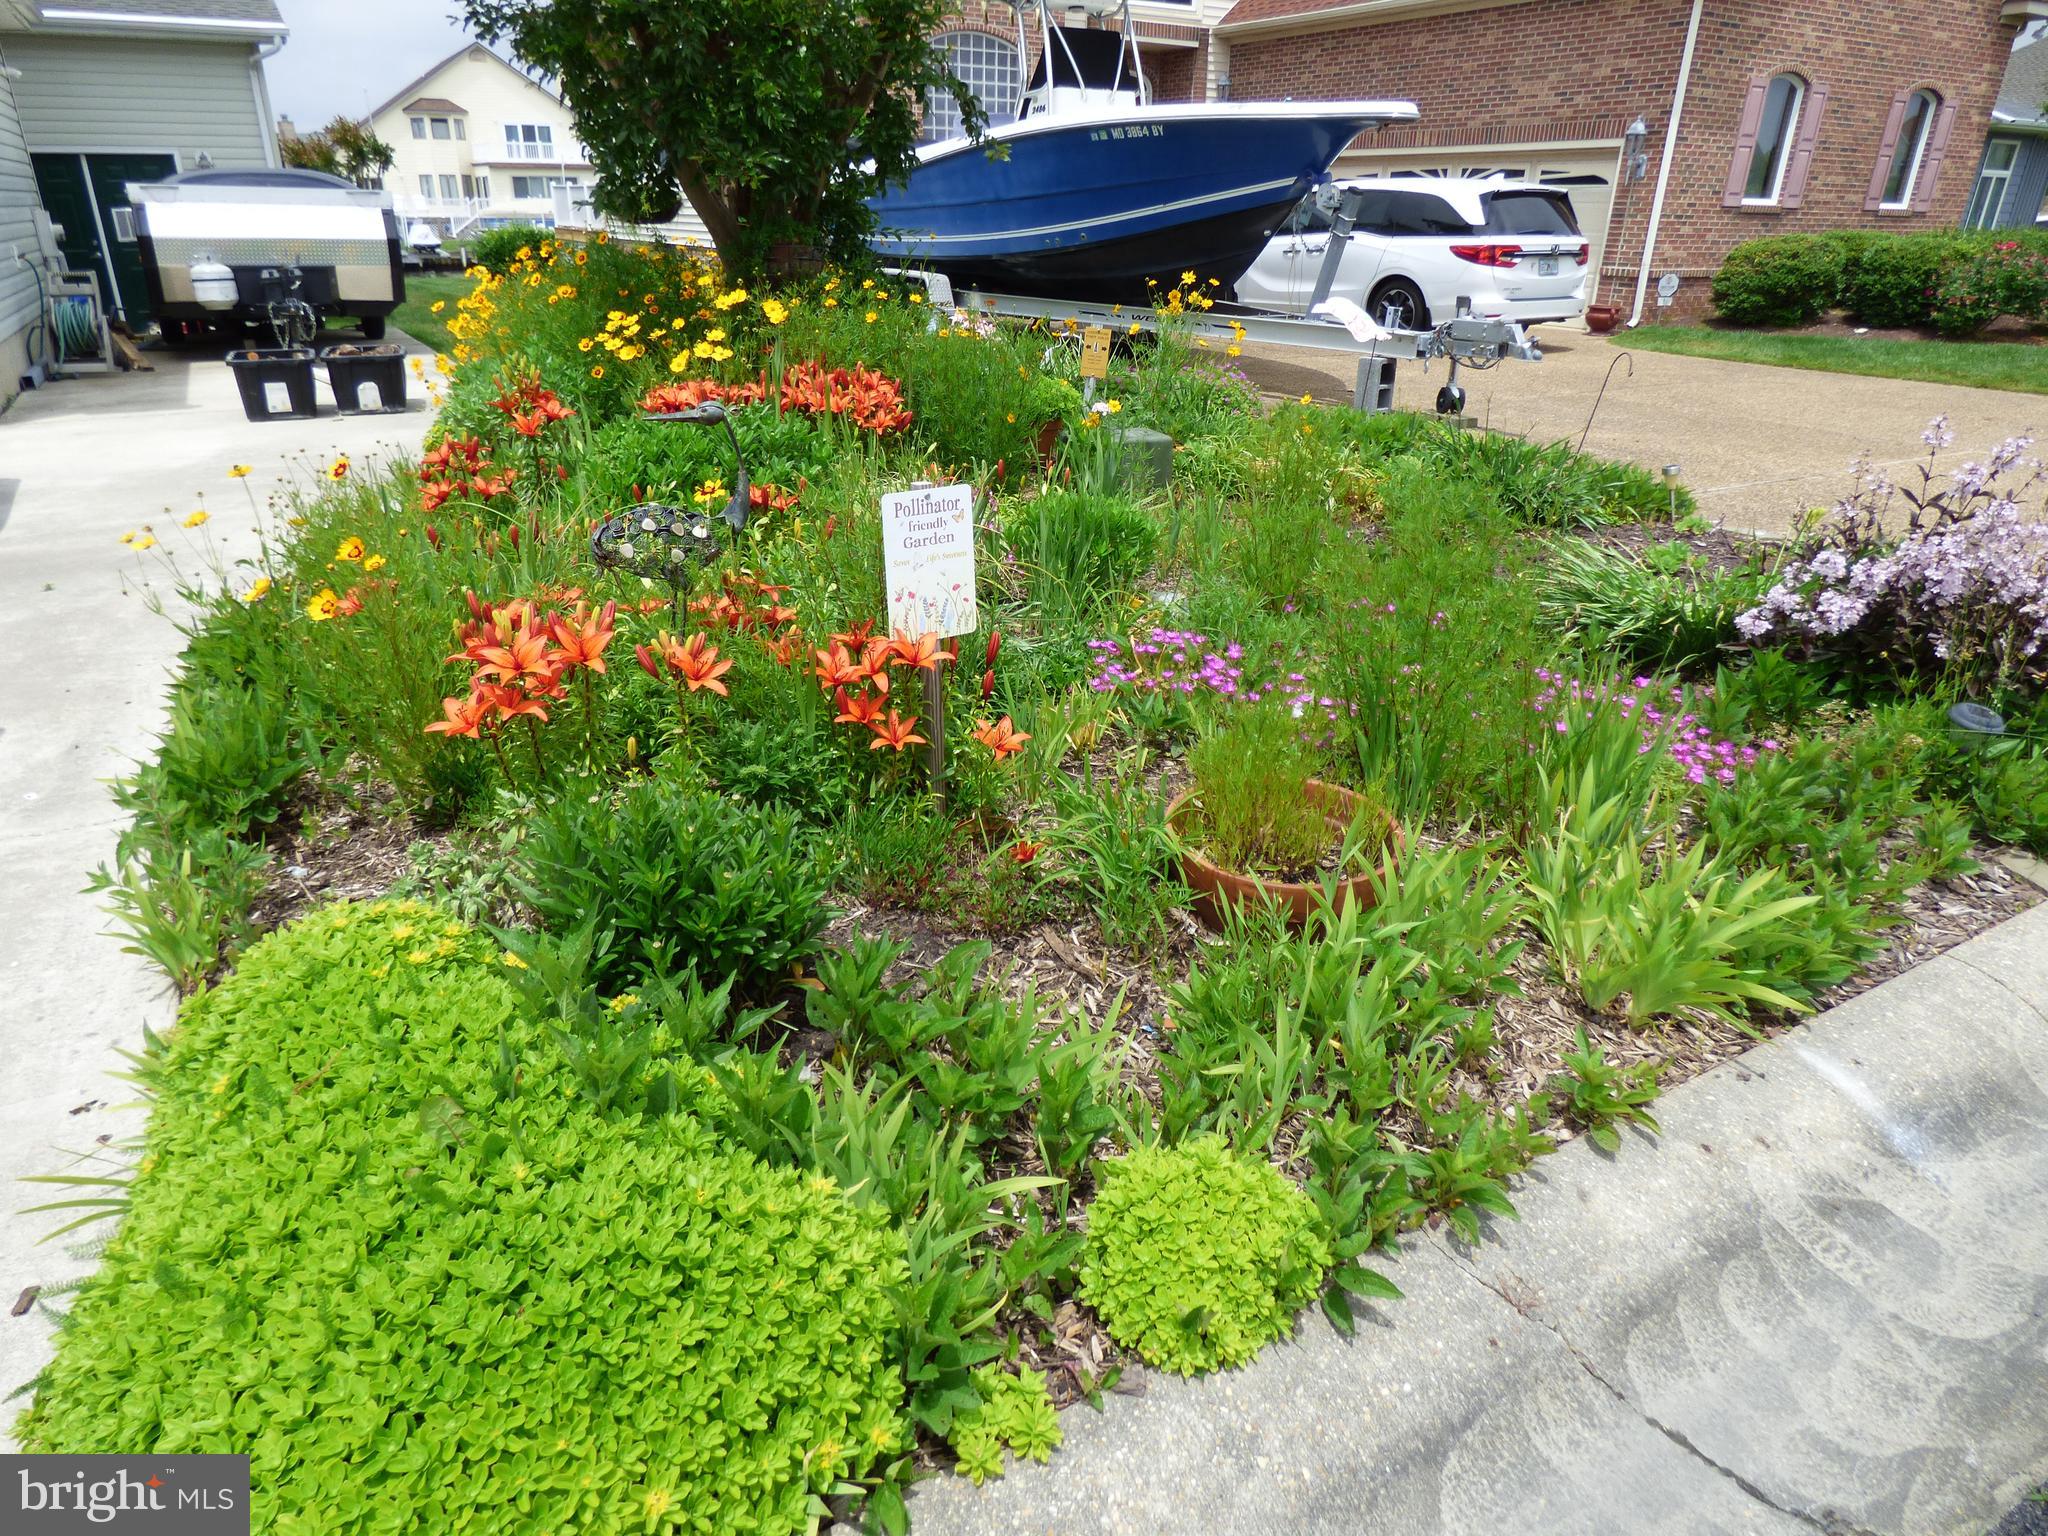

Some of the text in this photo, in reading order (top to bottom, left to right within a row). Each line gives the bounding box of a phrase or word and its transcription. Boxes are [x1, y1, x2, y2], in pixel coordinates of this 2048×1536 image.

[1111, 128, 1125, 140] MD
[893, 498, 960, 518] Pollinator
[908, 516, 948, 532] friendly
[903, 532, 954, 549] Garden
